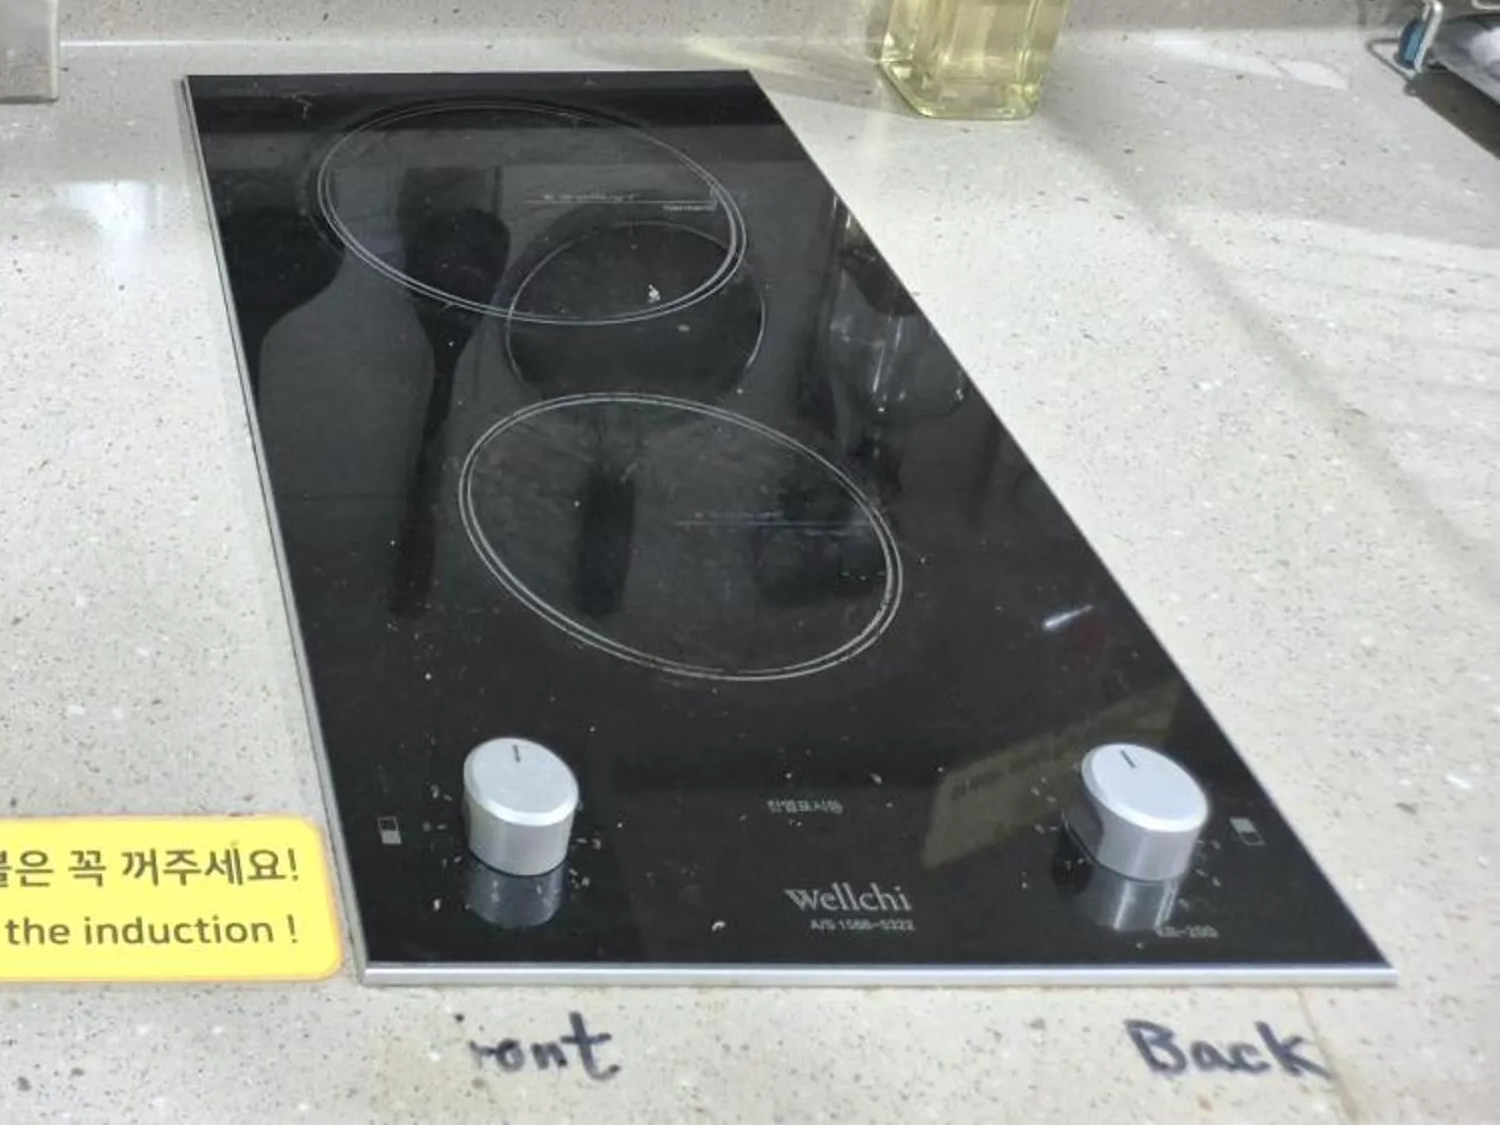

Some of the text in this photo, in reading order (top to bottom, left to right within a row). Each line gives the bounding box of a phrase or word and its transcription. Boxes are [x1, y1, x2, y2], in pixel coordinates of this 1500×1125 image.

[68, 849, 107, 888] 꼭
[121, 847, 299, 887] 꺼주세요!
[784, 881, 912, 911] Wellchi
[4, 916, 71, 946] the
[83, 916, 275, 945] induction
[466, 1010, 622, 1081] ront
[1125, 1018, 1330, 1077] Back
